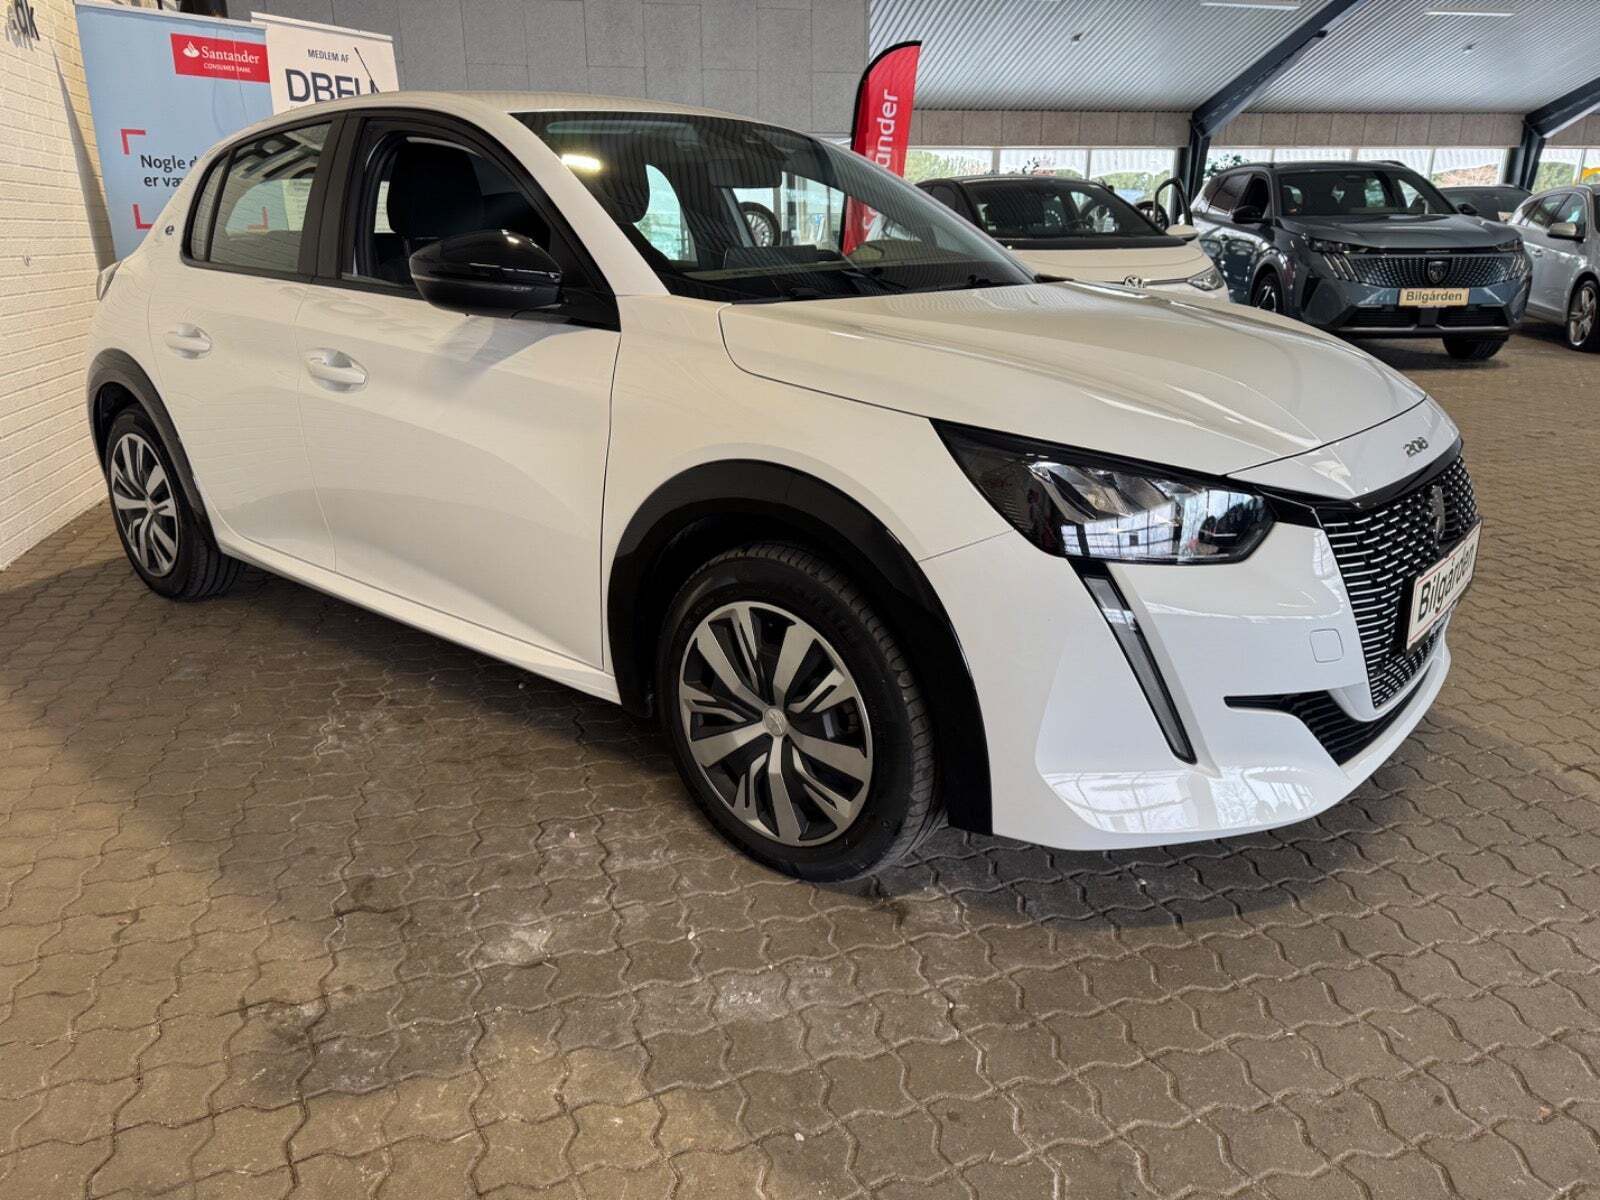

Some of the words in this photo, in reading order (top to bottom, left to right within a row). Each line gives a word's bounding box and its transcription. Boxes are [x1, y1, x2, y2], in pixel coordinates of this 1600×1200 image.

[201, 45, 259, 64] Santander
[308, 48, 339, 61] MEDLEM
[340, 54, 349, 63] AF
[203, 62, 235, 72] CONSUMER
[875, 88, 899, 168] ander
[141, 154, 186, 174] Nogle
[144, 176, 158, 187] er
[163, 177, 184, 188] væ
[1406, 291, 1462, 304] Bilgården
[1403, 436, 1429, 457] 208
[1418, 544, 1474, 622] Bilgården
